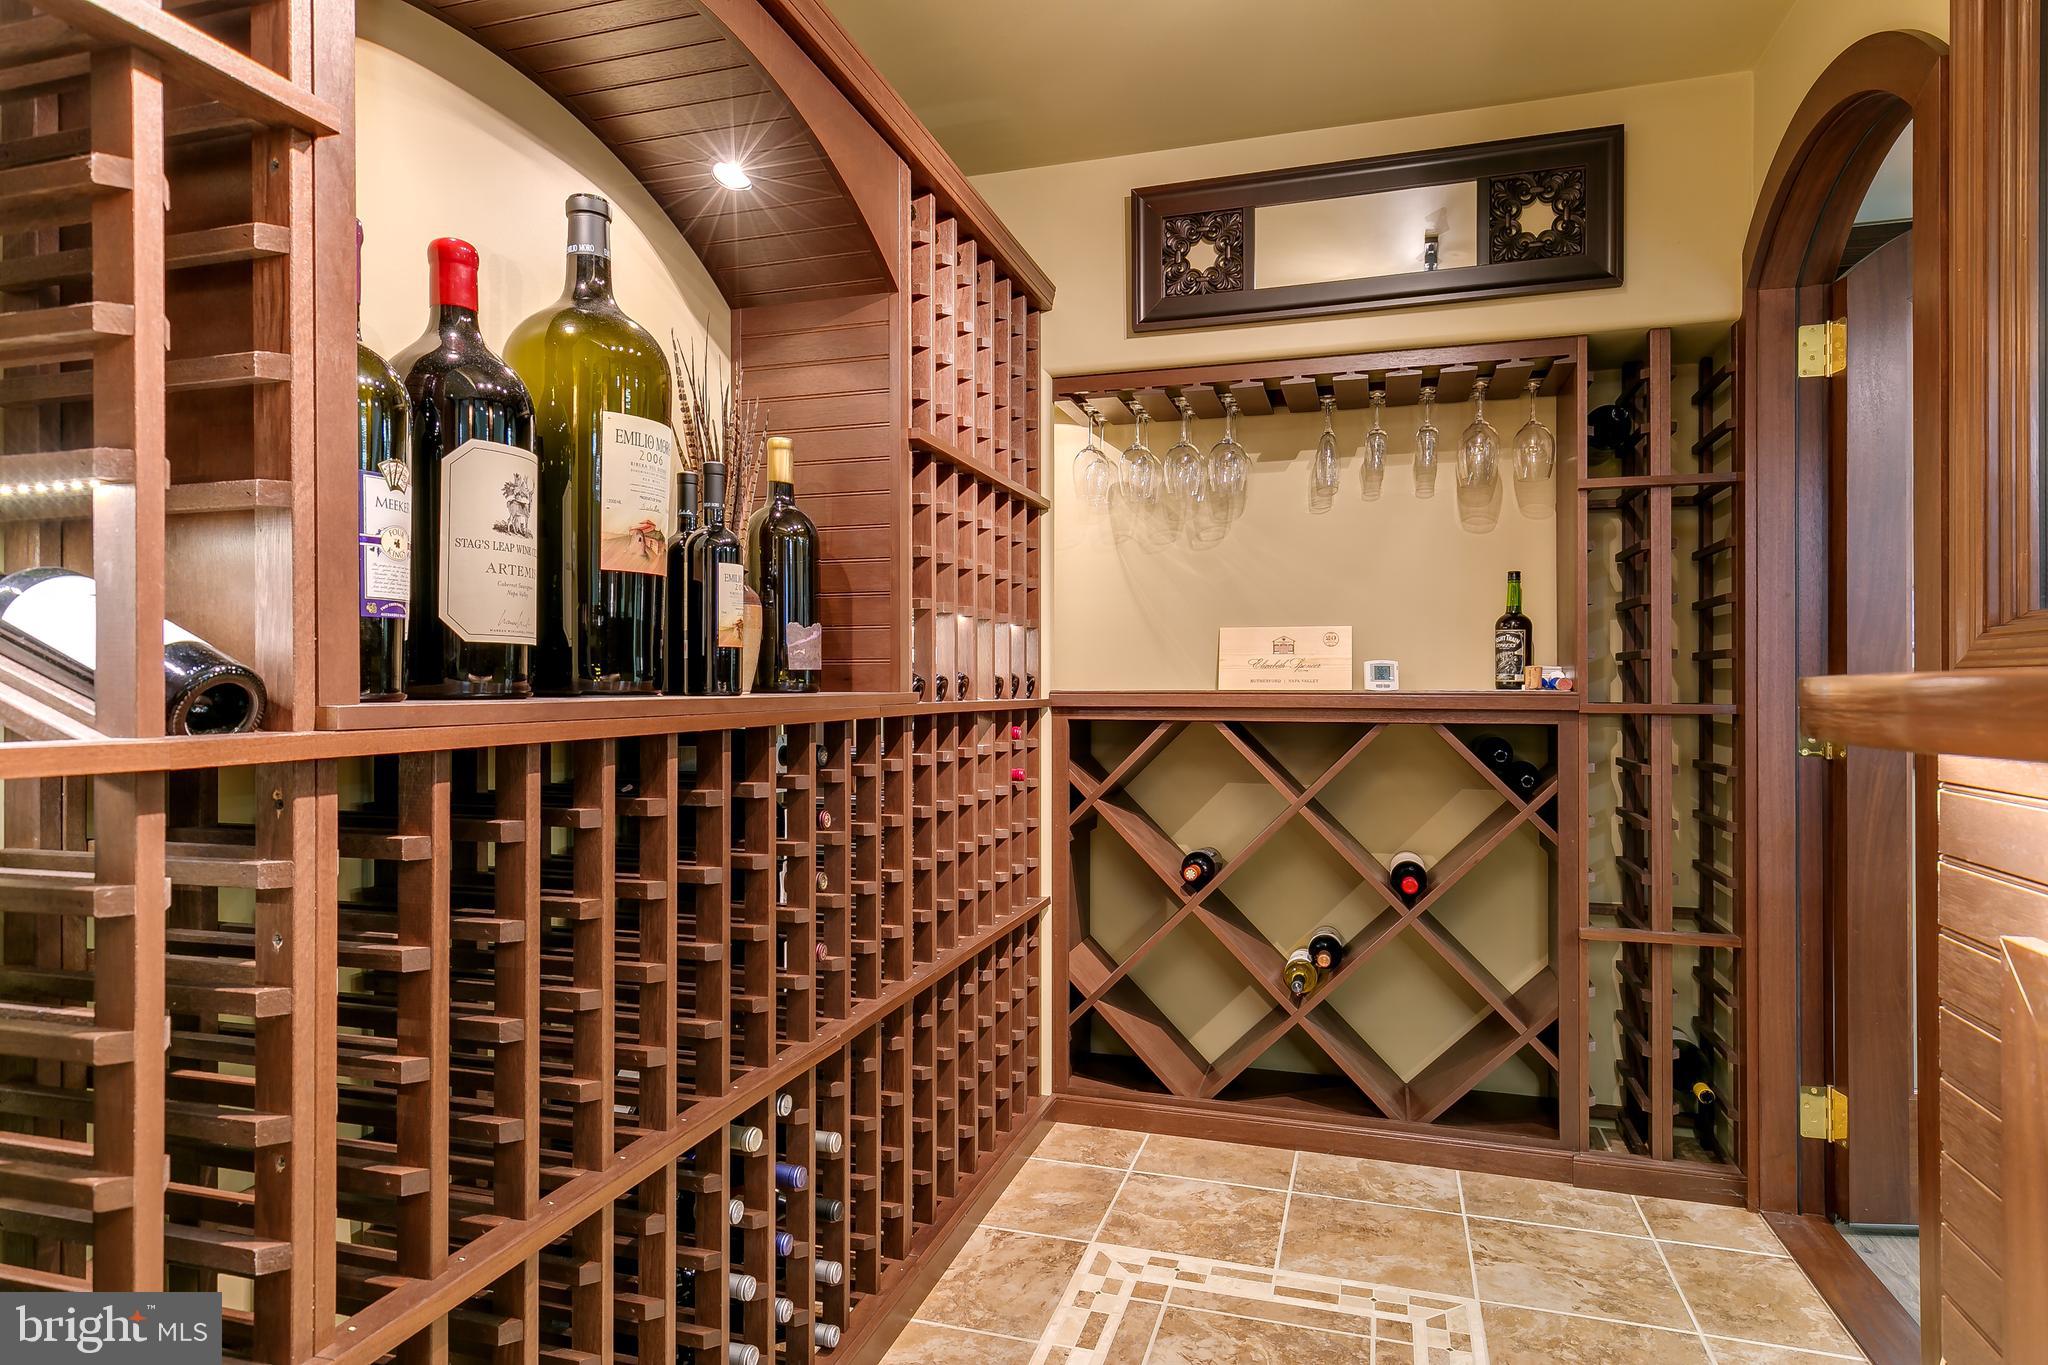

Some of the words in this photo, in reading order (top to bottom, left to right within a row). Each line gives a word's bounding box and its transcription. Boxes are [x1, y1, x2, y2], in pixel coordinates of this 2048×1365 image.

[615, 428, 655, 450] EMILIO
[640, 450, 664, 466] 2006
[375, 495, 409, 513] MEEKE
[454, 537, 490, 550] STAG'S
[493, 541, 515, 553] LEAP
[497, 580, 517, 588] Cabernet
[507, 590, 518, 598] Napa
[1248, 657, 1287, 669] Elizabeth
[1290, 657, 1321, 672] Spencer
